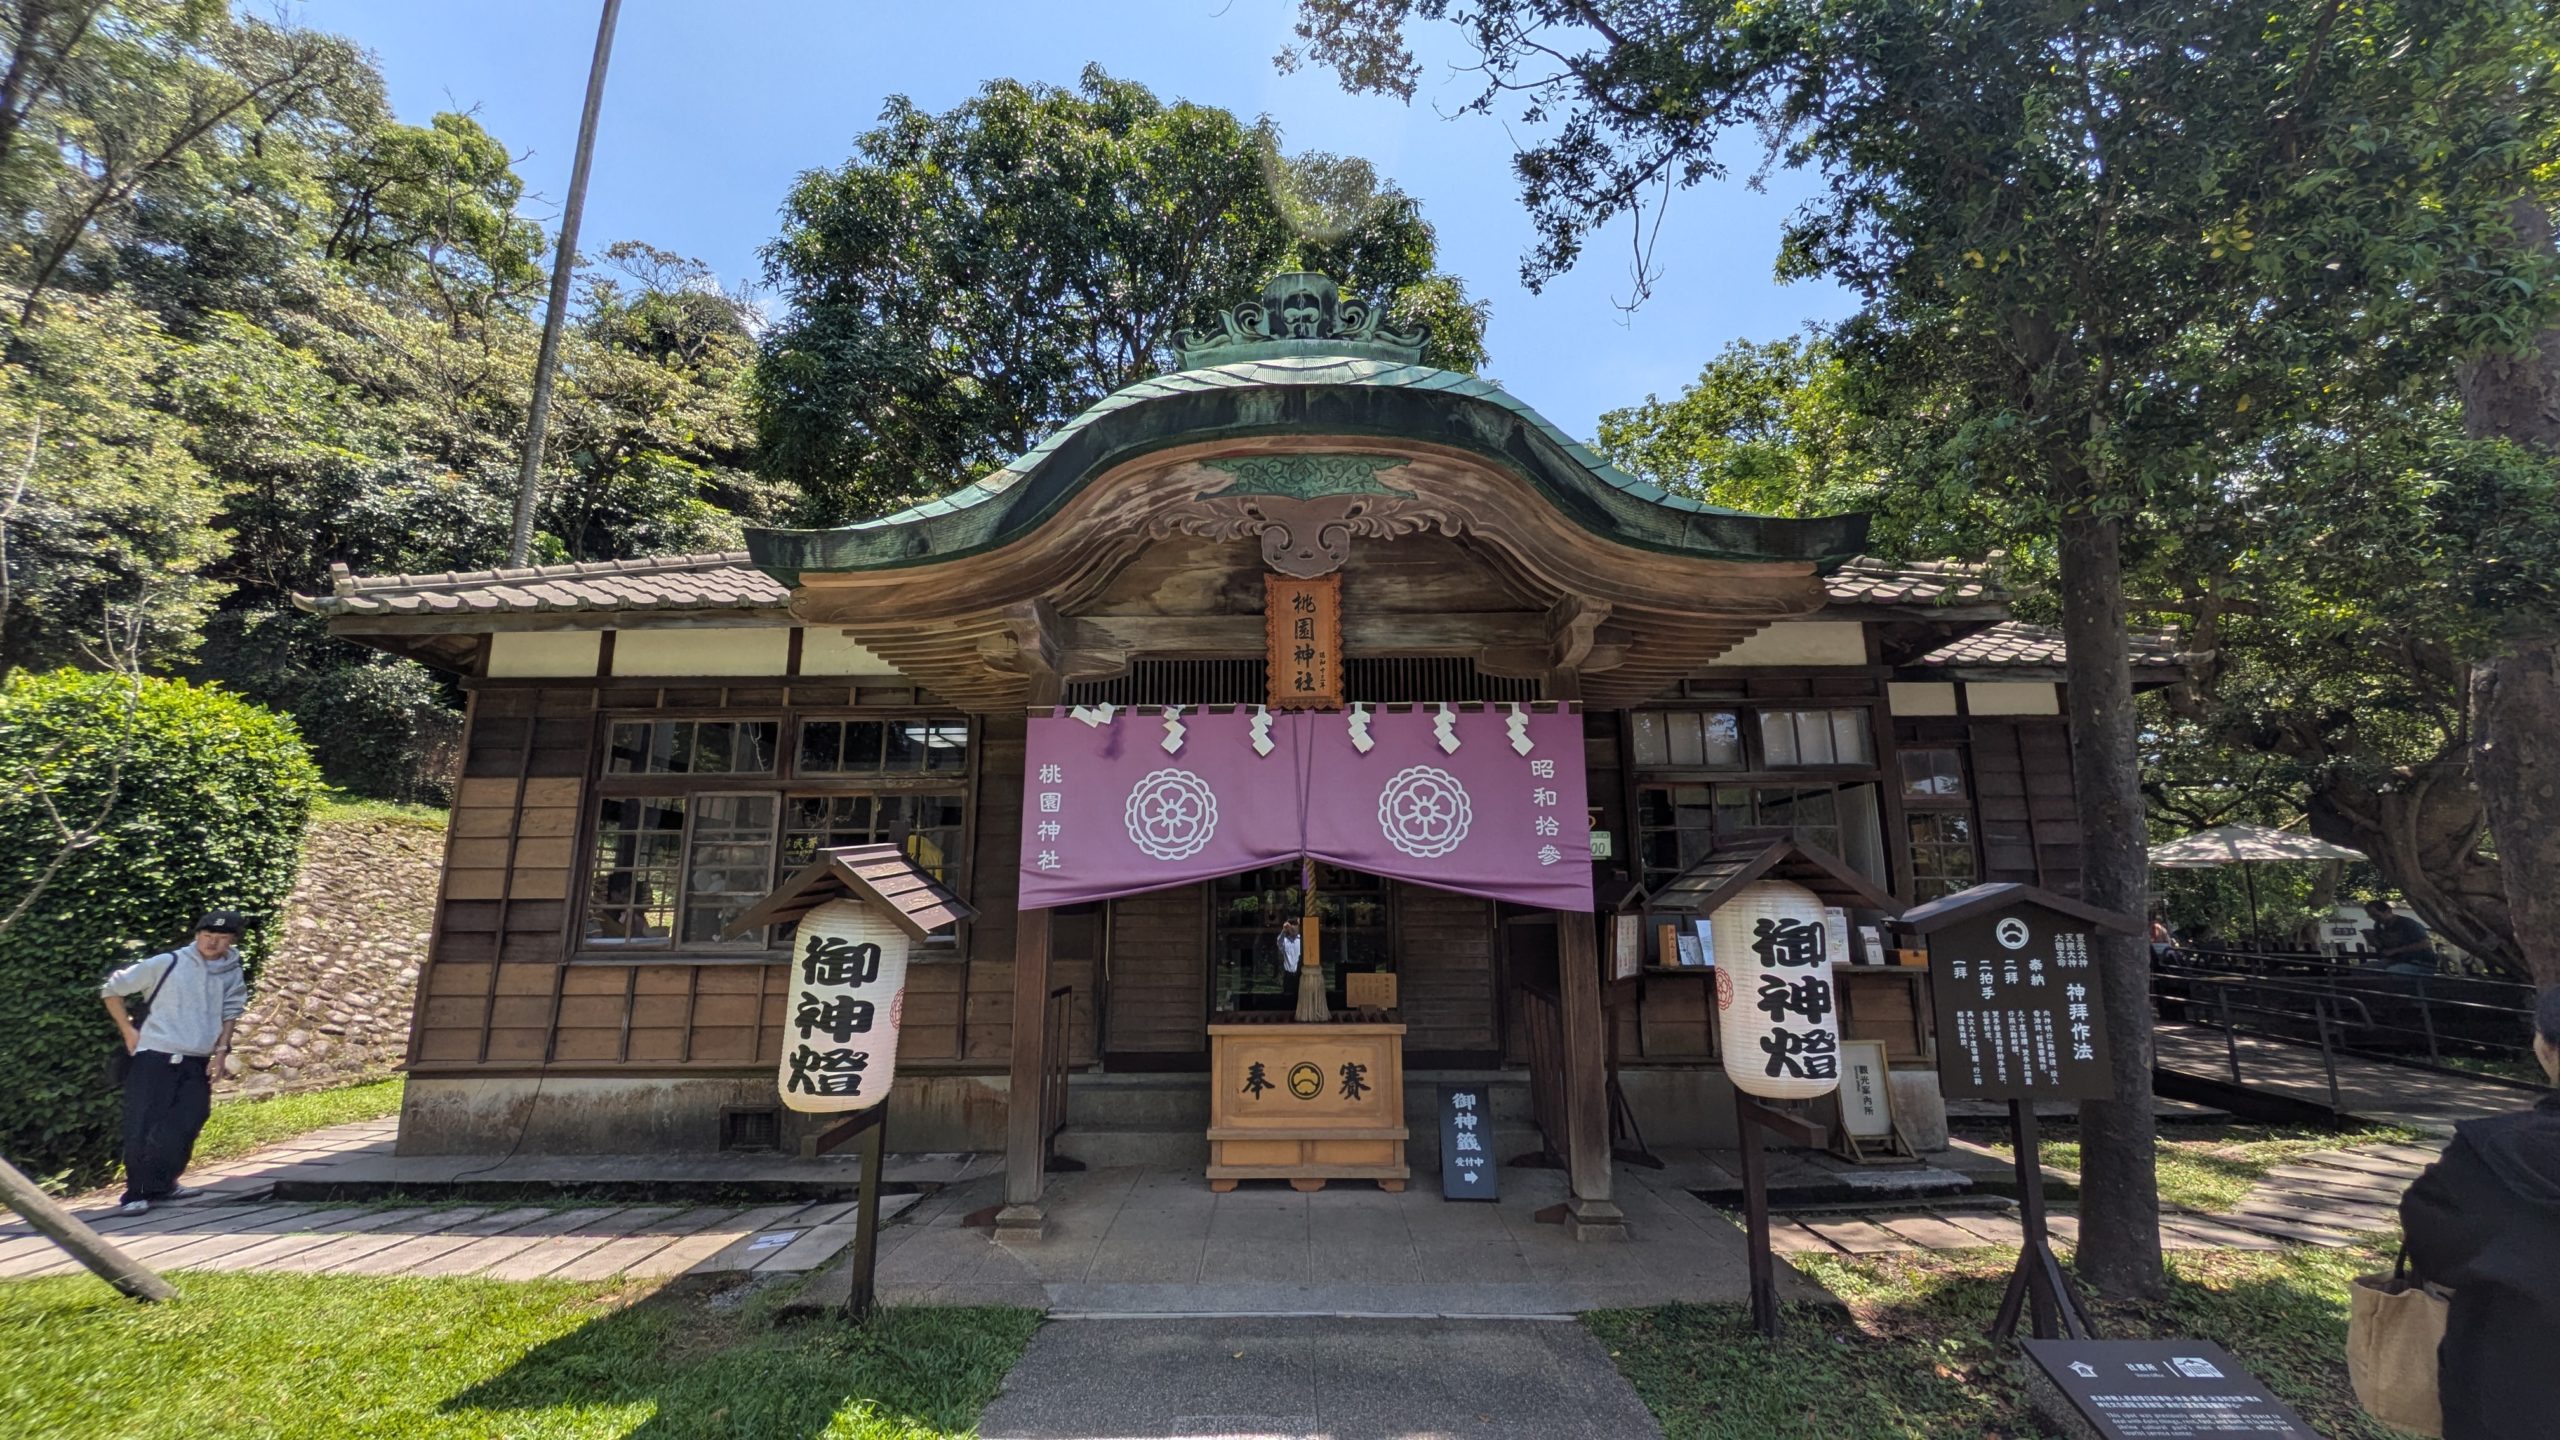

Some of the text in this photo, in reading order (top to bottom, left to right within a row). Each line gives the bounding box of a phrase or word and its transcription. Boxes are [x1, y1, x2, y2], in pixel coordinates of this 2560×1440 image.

[1291, 591, 1317, 693] 桃園神社
[1036, 763, 1063, 872] 桃園神社
[1531, 759, 1562, 867] 昭和拾參
[1952, 959, 1968, 979] 一拜
[1978, 959, 1996, 1000] 二拍手
[2003, 959, 2019, 985] 二拜
[2028, 958, 2045, 986] 奉納
[786, 935, 882, 1097] 御神燈
[1751, 917, 1838, 1081] 御神燈
[2066, 983, 2094, 1061] 神拜作法
[1241, 1061, 1372, 1101] 奉 賽
[1451, 1092, 1482, 1151] 御神籤
[1454, 1156, 1485, 1168] 受付中
